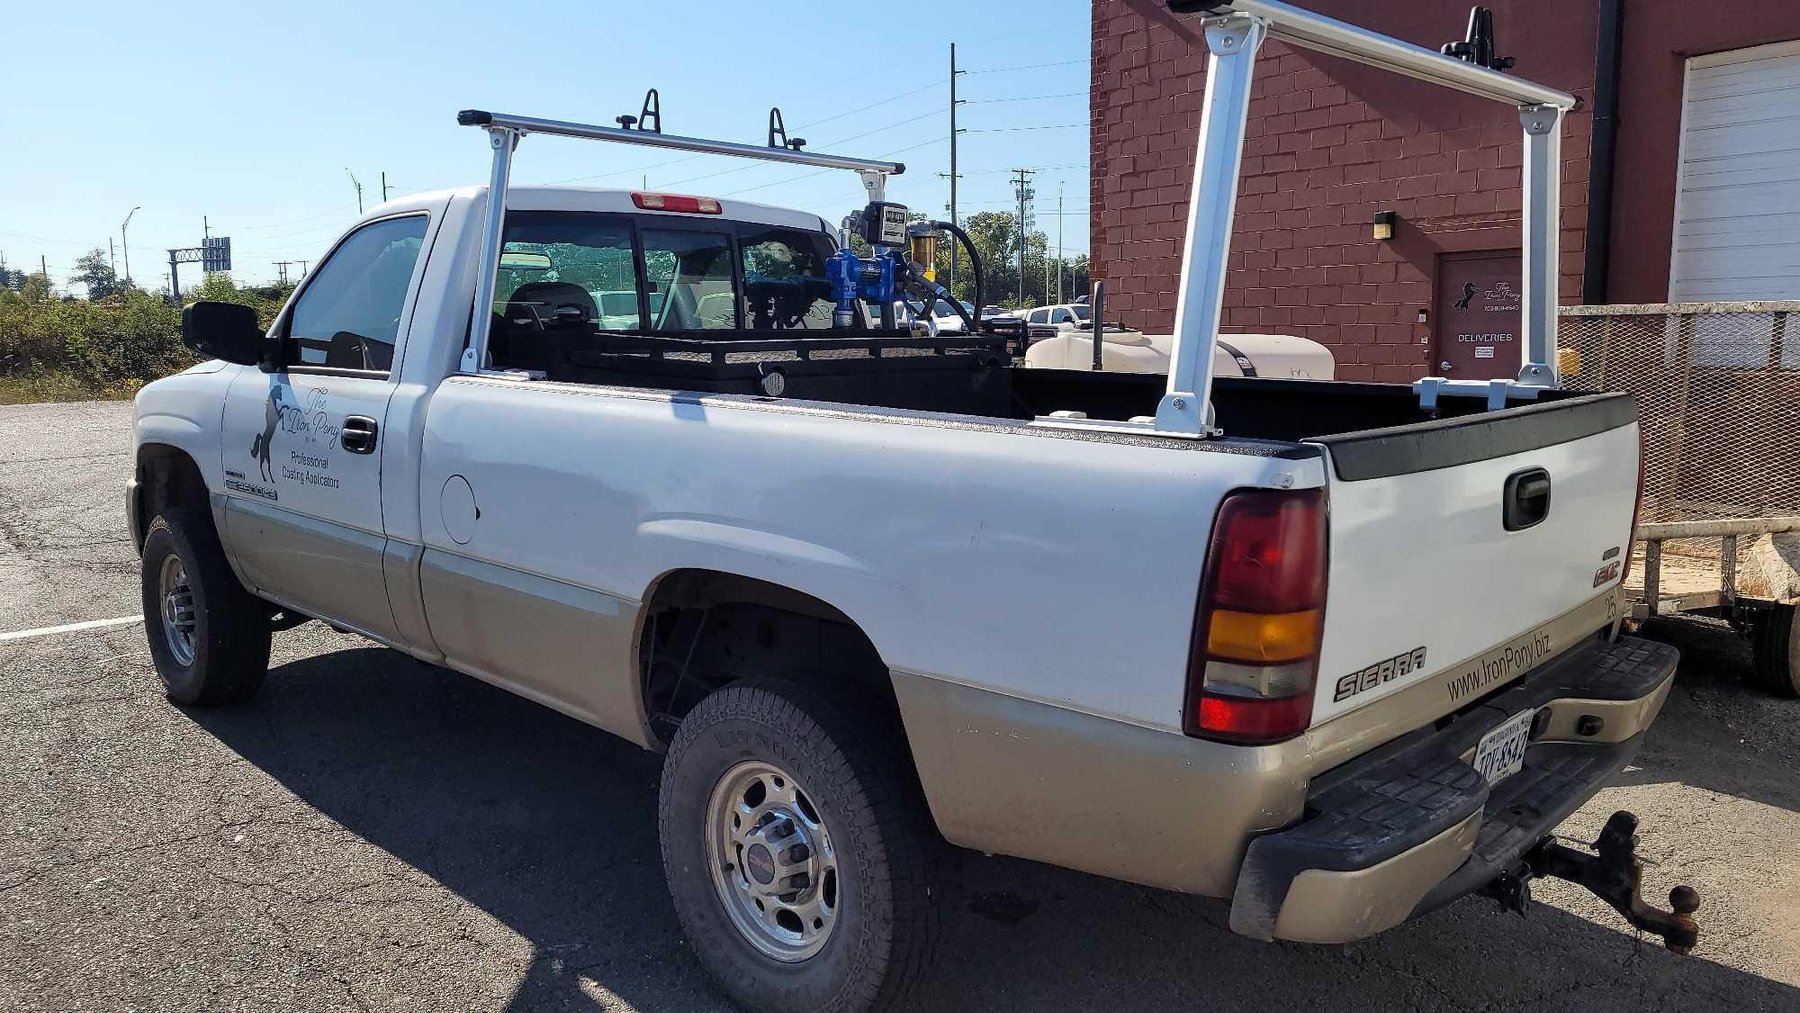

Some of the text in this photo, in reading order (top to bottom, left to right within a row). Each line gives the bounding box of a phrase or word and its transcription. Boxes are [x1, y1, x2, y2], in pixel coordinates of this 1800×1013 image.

[1458, 333, 1513, 343] DELIVERIES
[305, 387, 328, 415] The
[288, 408, 339, 450] Iron Pony
[291, 450, 329, 469] Professional
[282, 465, 340, 489] Coating Applicators
[1334, 645, 1428, 702] SIERRA
[1447, 632, 1551, 702] www.IronPony.biz
